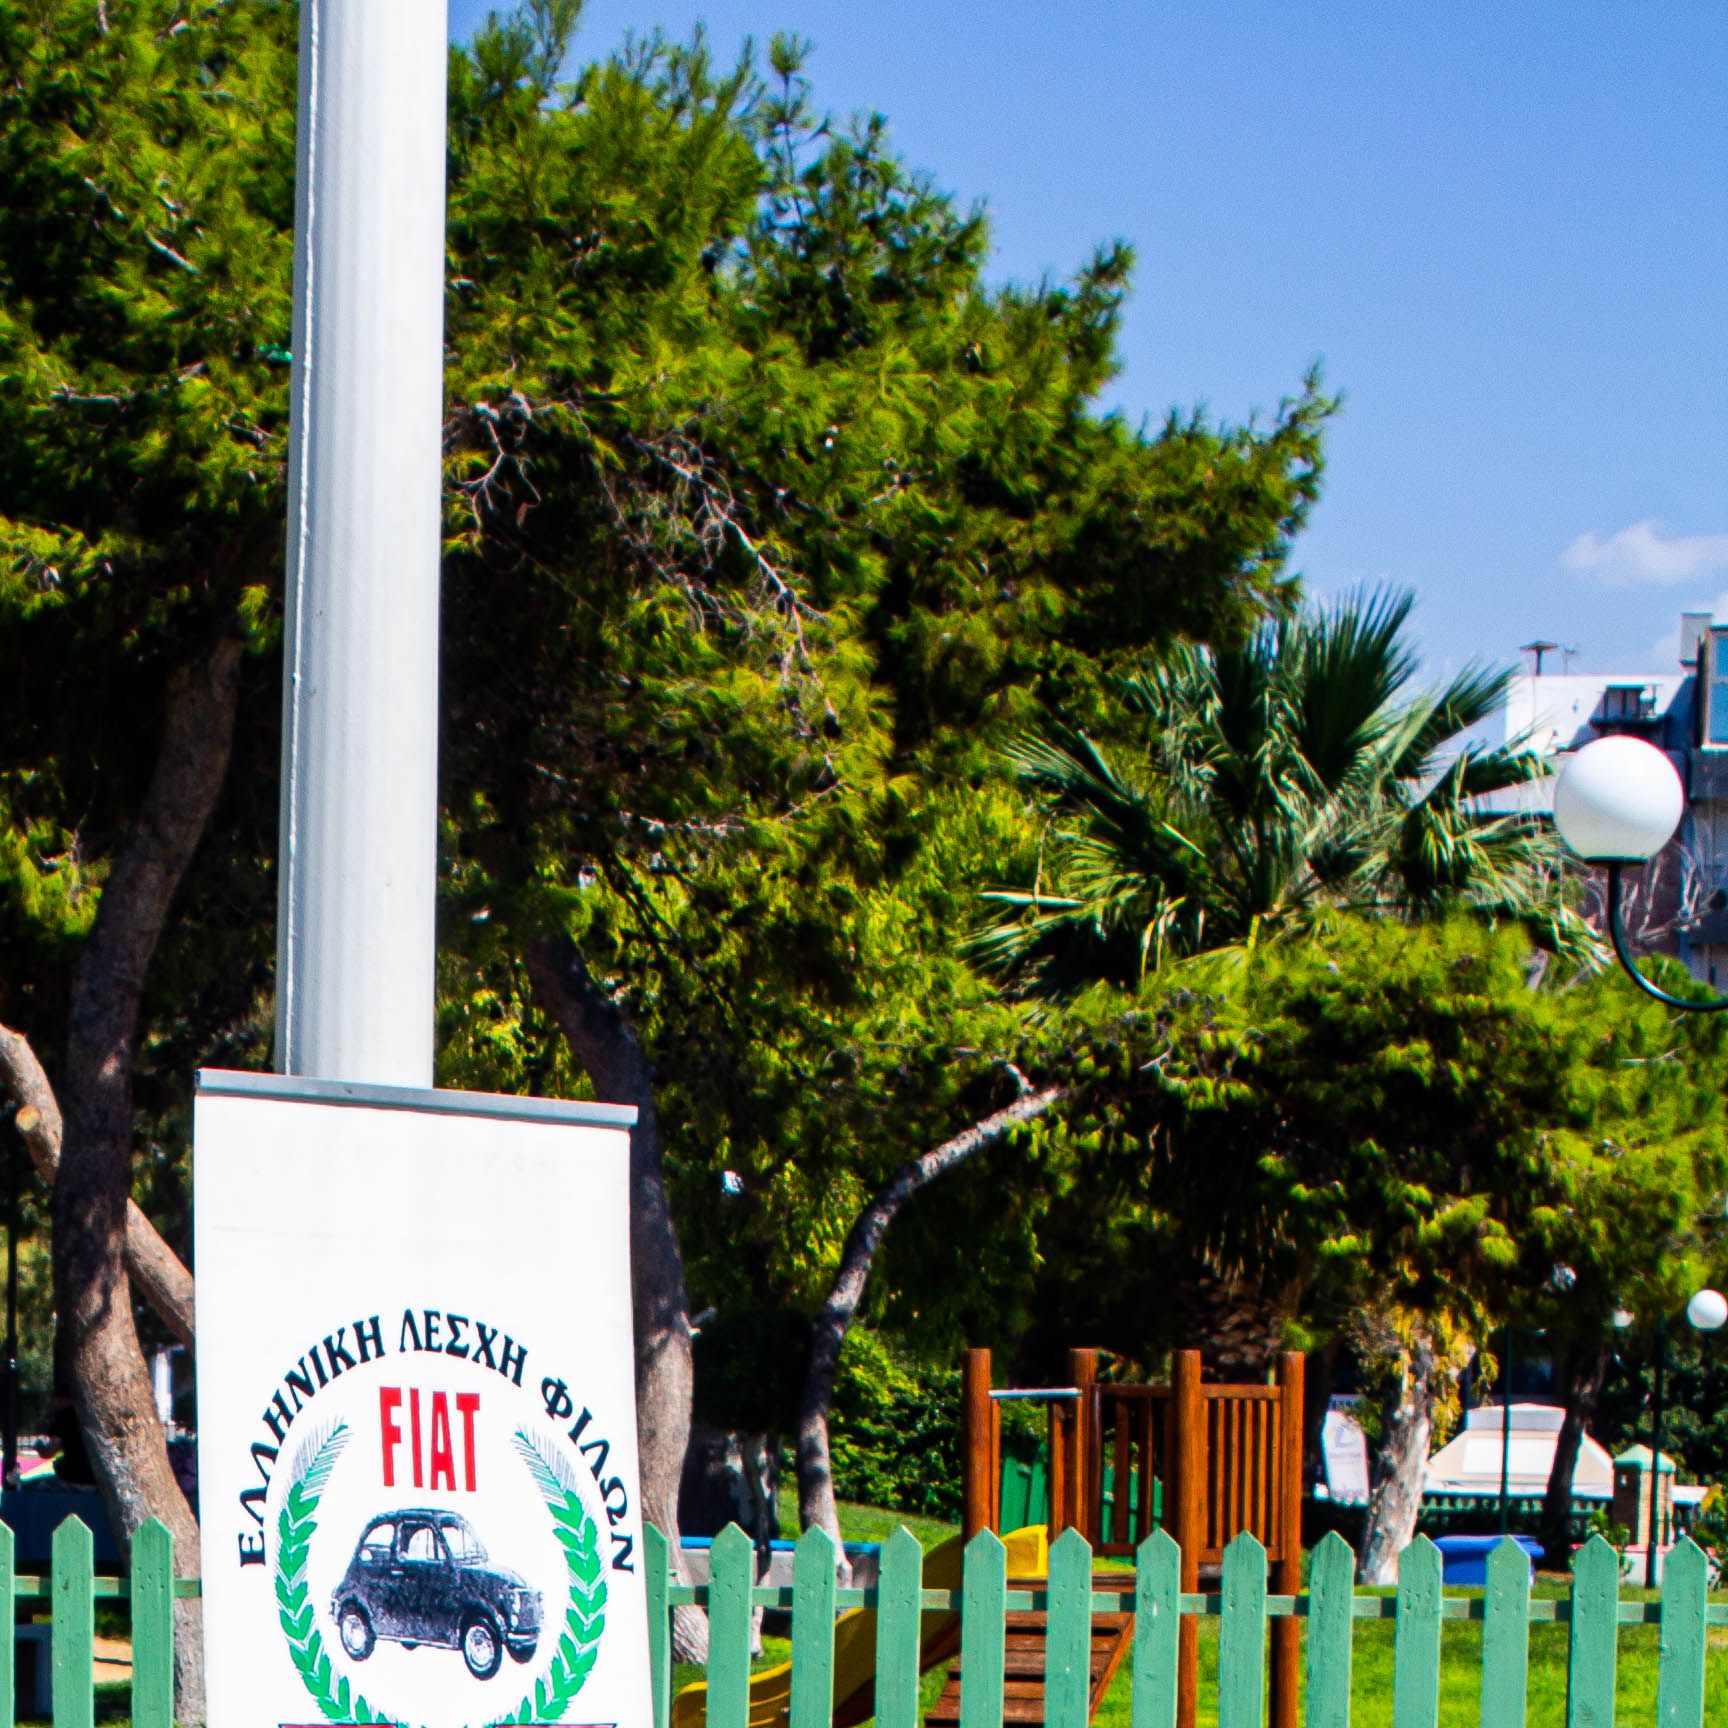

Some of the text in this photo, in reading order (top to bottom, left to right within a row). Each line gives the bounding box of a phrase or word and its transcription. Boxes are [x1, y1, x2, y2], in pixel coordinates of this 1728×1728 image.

[238, 1308, 635, 1575] ΕΛΛΗΝΙΚΗ ΛΕΣΧΗ ΦΙΛΩΝ
[378, 1386, 481, 1493] FIAT
